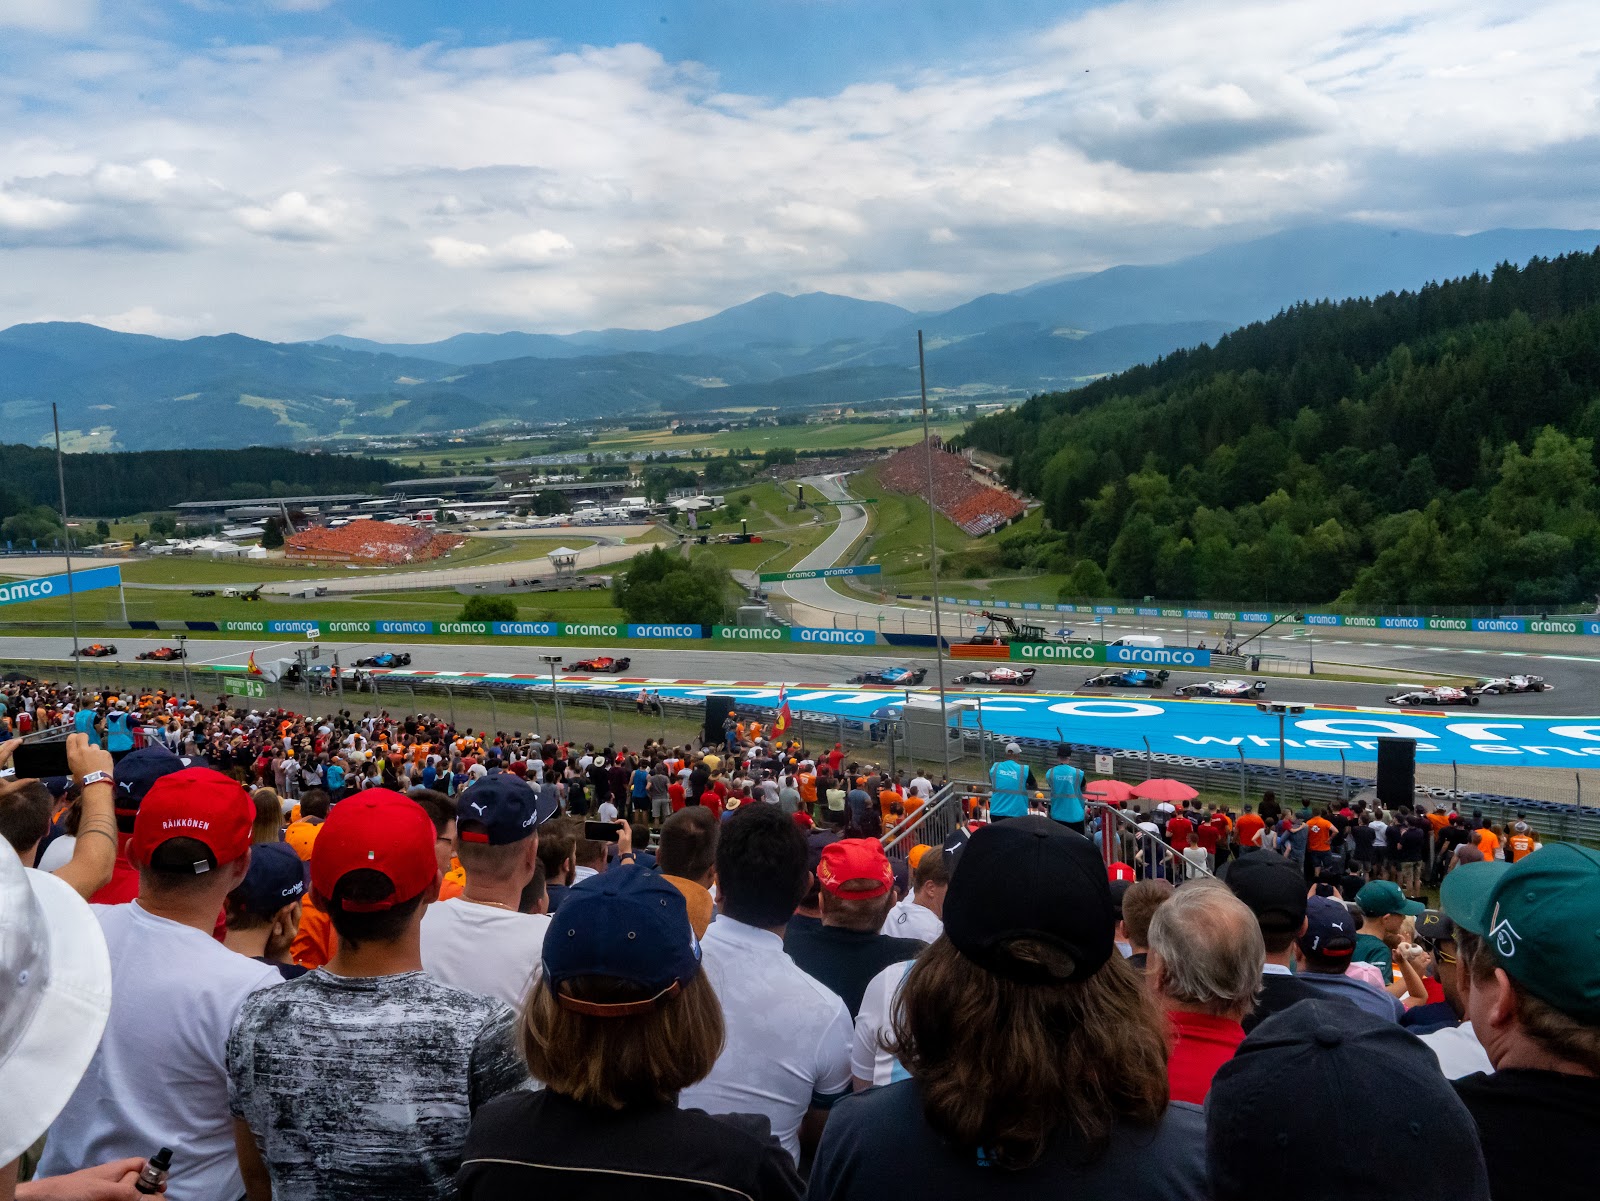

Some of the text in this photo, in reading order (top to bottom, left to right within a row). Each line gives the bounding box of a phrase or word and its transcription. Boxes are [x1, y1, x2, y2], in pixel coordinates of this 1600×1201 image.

[787, 568, 854, 579] aramco aramco
[1162, 609, 1182, 617] aramco
[1214, 612, 1236, 620] aramco
[1243, 613, 1267, 622] aramco
[227, 622, 264, 631] aramco
[275, 622, 313, 631] aramco
[1345, 617, 1376, 626] aramco
[1385, 618, 1418, 628] aramco
[1430, 620, 1466, 630] aramco
[1478, 621, 1518, 631] aramco
[329, 622, 370, 632] aramco
[383, 622, 425, 632] aramco
[440, 623, 486, 633] aramco
[500, 623, 549, 634] aramco
[565, 624, 618, 635] aramco
[636, 626, 693, 637] aramco
[1531, 622, 1576, 632] aramco
[722, 628, 781, 639] aramco
[801, 629, 865, 643] aramco
[1021, 645, 1095, 659] aramco
[1119, 648, 1195, 664] aramco
[163, 818, 210, 830] RÄIKKÖNEN
